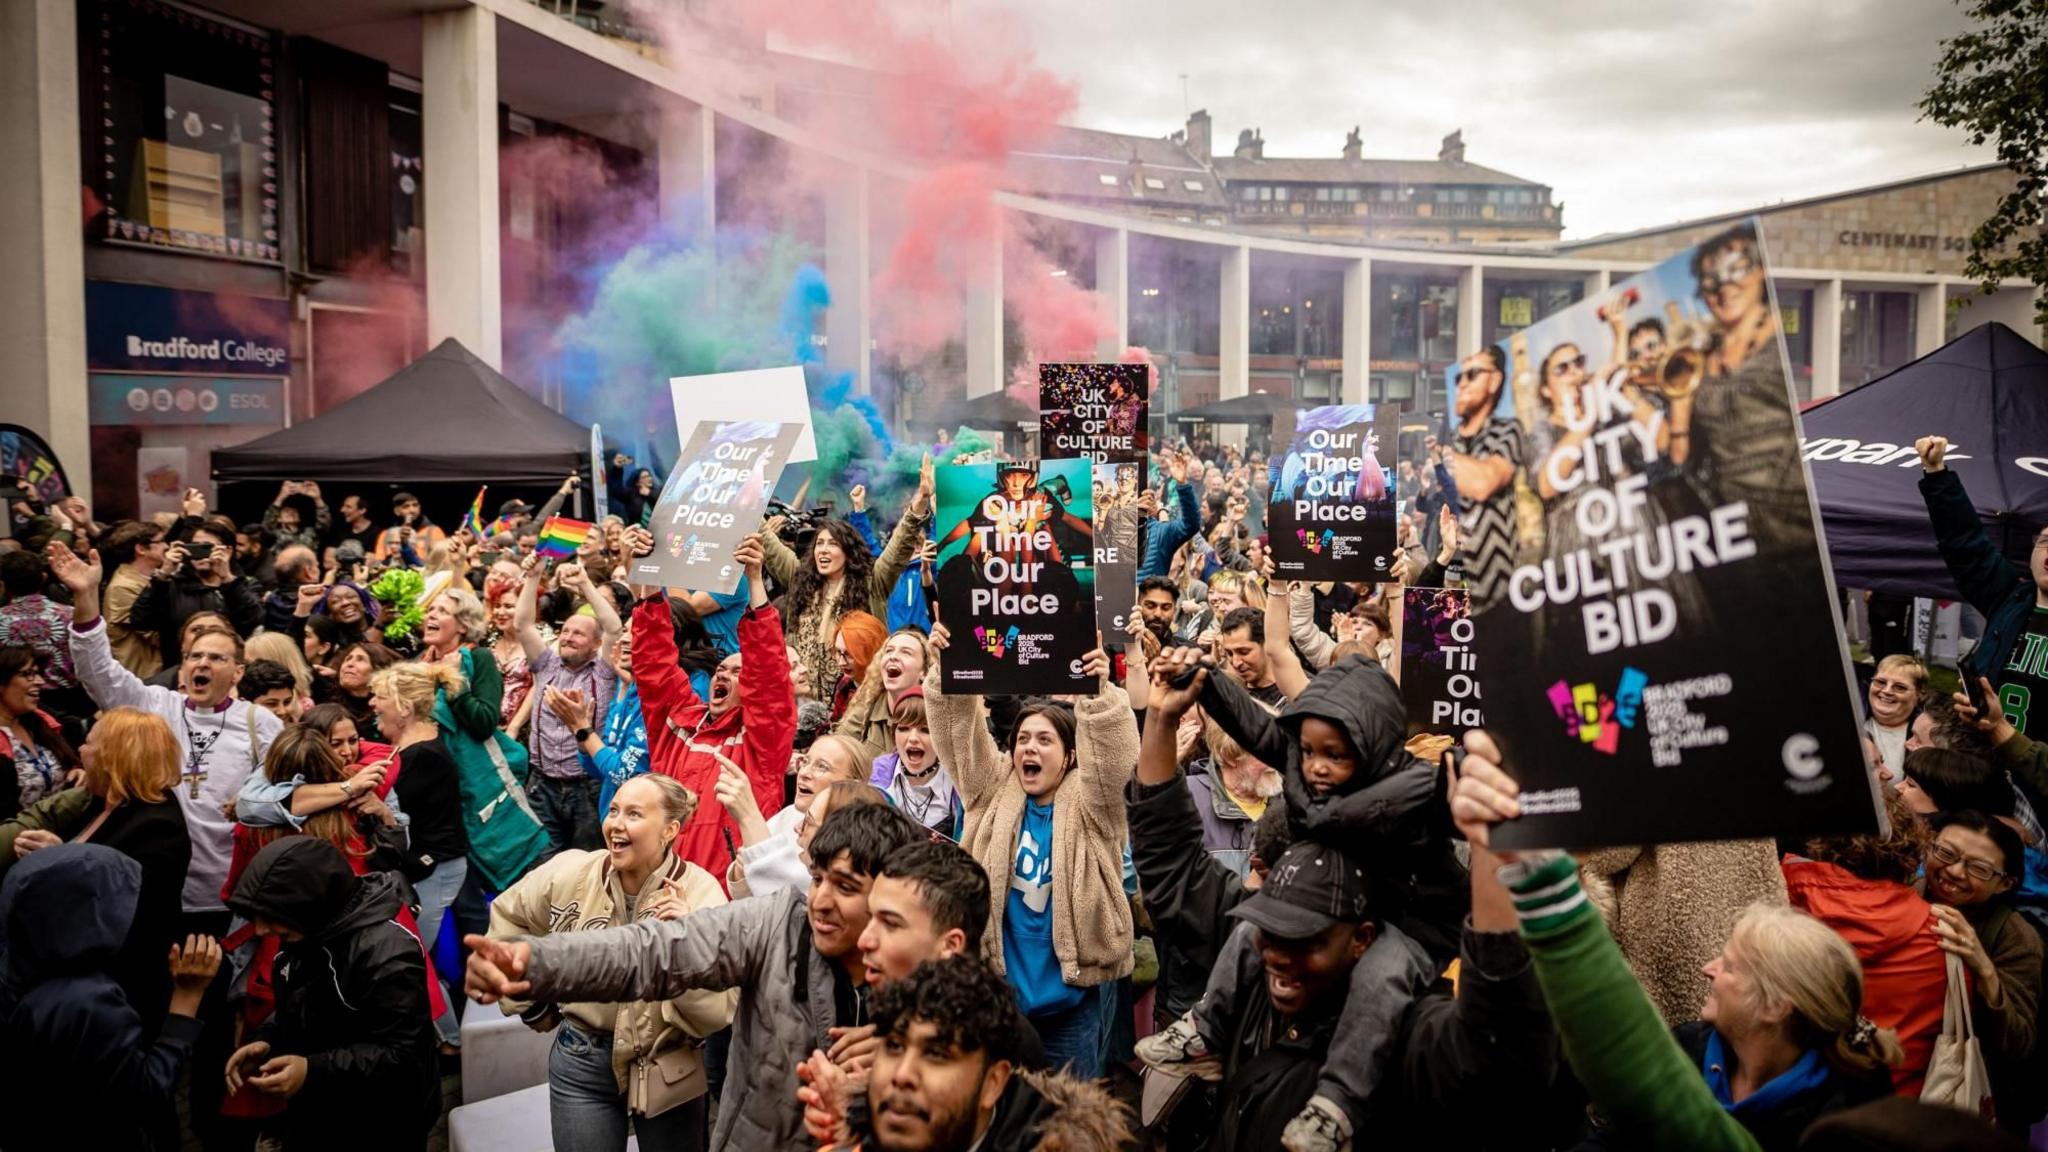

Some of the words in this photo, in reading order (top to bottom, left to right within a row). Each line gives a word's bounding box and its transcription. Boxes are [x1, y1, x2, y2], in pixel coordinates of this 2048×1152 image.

[1838, 230, 1938, 249] CENTENARY
[127, 335, 220, 359] Bradford
[223, 340, 286, 367] College
[230, 393, 270, 409] ESOL
[1082, 388, 1106, 403] UK
[1563, 369, 1635, 432] UK
[1074, 404, 1113, 418] CITY
[1082, 420, 1106, 434] OF
[1056, 435, 1132, 450] CULTURE
[1309, 429, 1357, 449] Our
[715, 442, 757, 460] Our
[1547, 410, 1664, 492] CITY
[701, 462, 751, 482] Time
[1300, 452, 1363, 473] Time
[693, 484, 736, 504] Our
[1306, 476, 1356, 497] Our
[983, 494, 1042, 521] Our
[1295, 500, 1367, 521] Place
[1575, 473, 1648, 536] OF
[672, 504, 735, 528] Place
[973, 524, 1052, 552] Time
[1508, 501, 1757, 613] CULTURE
[983, 556, 1045, 584] Our
[971, 588, 1060, 616] Place
[1582, 588, 1677, 654] BID
[1028, 646, 1041, 654] City
[1432, 700, 1485, 726] Pla
